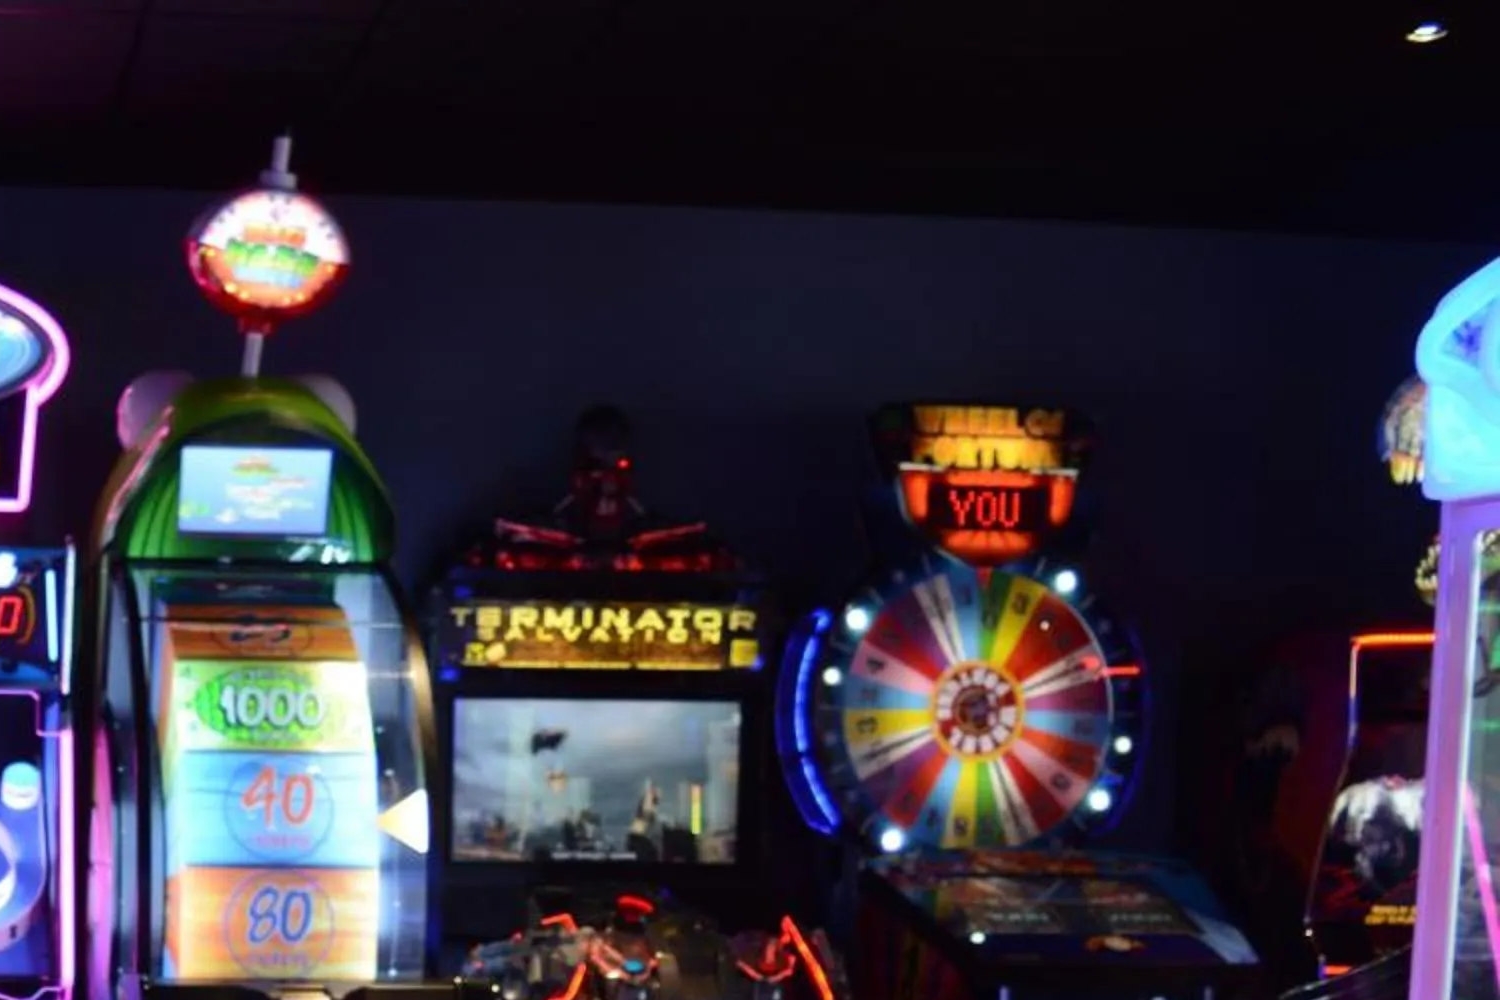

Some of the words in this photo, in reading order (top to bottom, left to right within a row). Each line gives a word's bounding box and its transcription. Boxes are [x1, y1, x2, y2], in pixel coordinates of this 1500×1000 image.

[950, 490, 1020, 528] YOU
[451, 607, 756, 631] TERMINATOR
[478, 626, 722, 645] SALVATION
[221, 685, 324, 726] 1000
[241, 764, 314, 827] 40
[247, 885, 312, 943] 80
